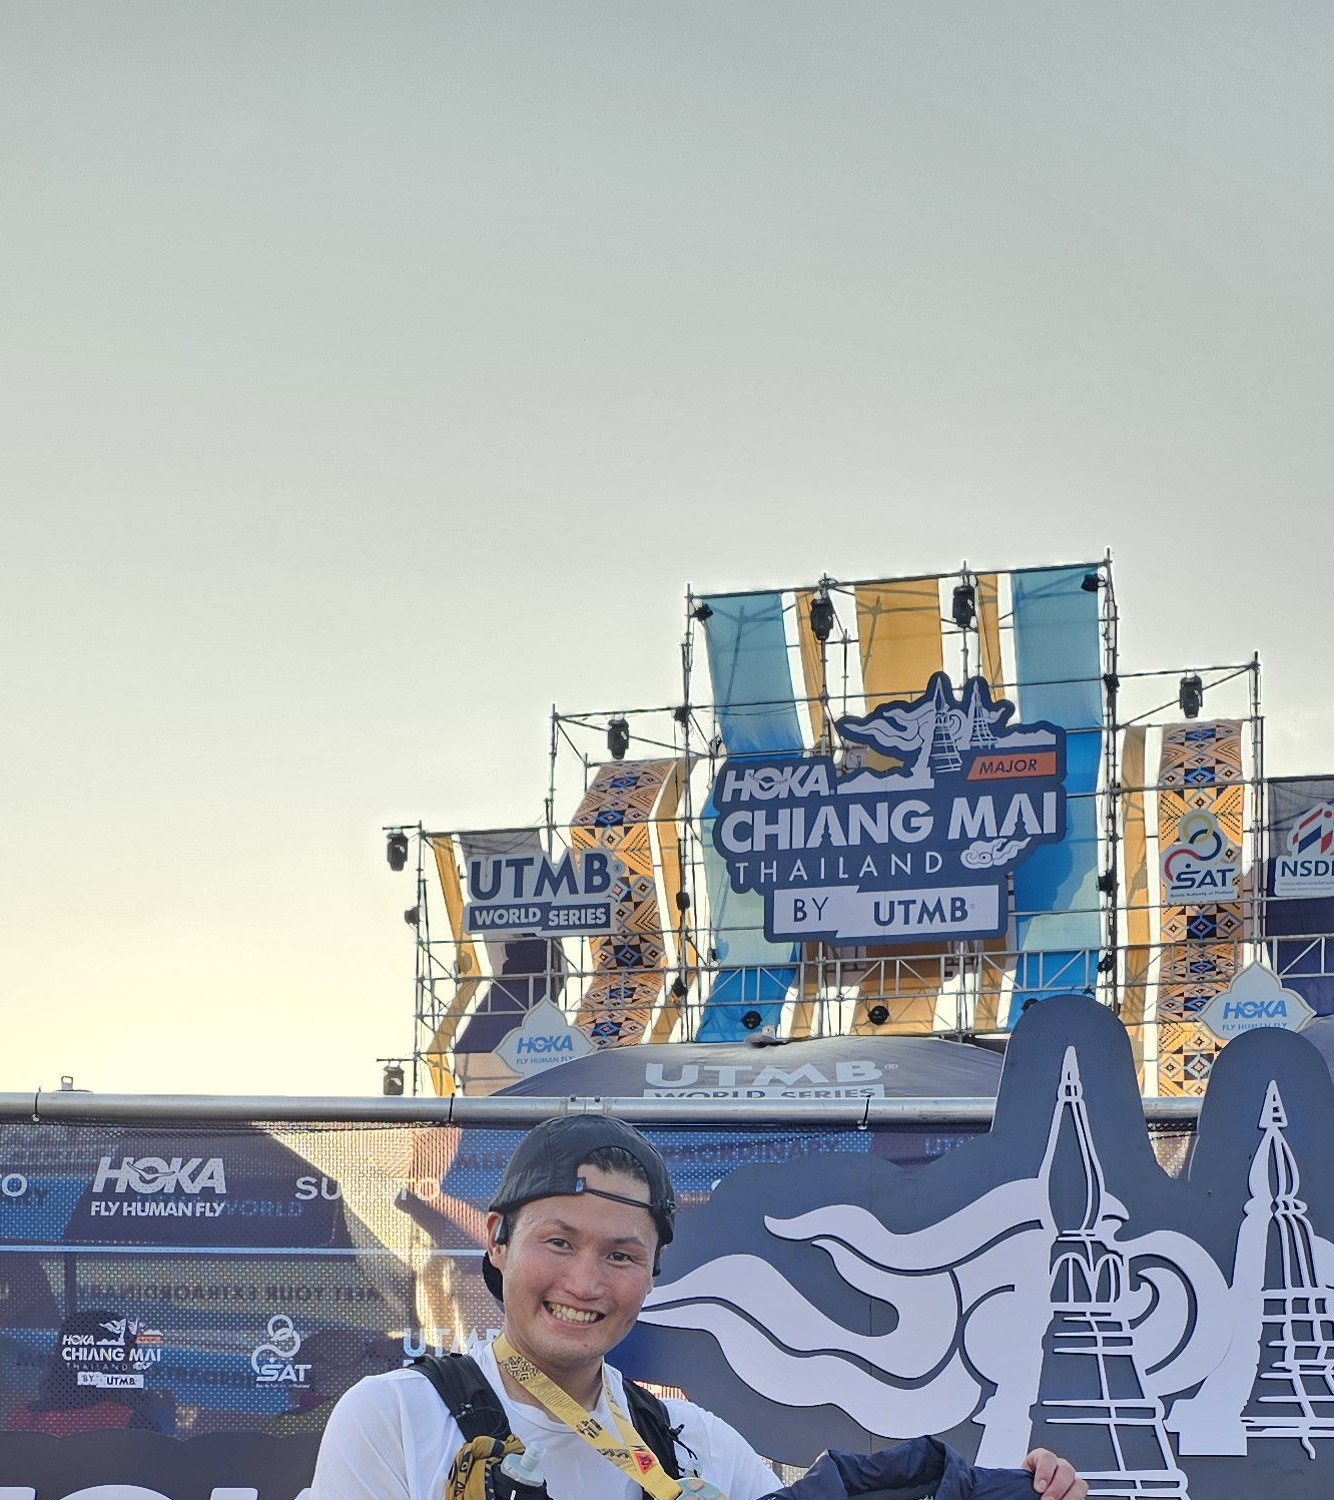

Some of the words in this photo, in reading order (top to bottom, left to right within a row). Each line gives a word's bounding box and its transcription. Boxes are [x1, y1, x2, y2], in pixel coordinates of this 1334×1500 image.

[979, 758, 1038, 776] MAJOR
[722, 764, 831, 802] HOKA
[721, 800, 934, 854] CHIANG
[948, 791, 1057, 841] MAI
[735, 851, 943, 885] THAILAND
[1170, 867, 1236, 891] SAT
[474, 907, 542, 926] WORLD
[548, 907, 607, 927] SERIES
[793, 897, 828, 923] BY
[873, 896, 968, 926] UTMB
[1222, 999, 1288, 1021] HOKA
[516, 1034, 575, 1055] HOKA
[91, 1156, 227, 1194] HOKA
[91, 1201, 120, 1217] FLY
[122, 1201, 193, 1217] HUMAN
[195, 1202, 227, 1218] FLY
[62, 1334, 95, 1346] HOKA
[62, 1347, 125, 1362] CHIANG
[128, 1347, 161, 1362] MAI
[82, 1375, 94, 1384] BY
[106, 1376, 137, 1386] UTMB
[256, 1364, 312, 1382] SAT
